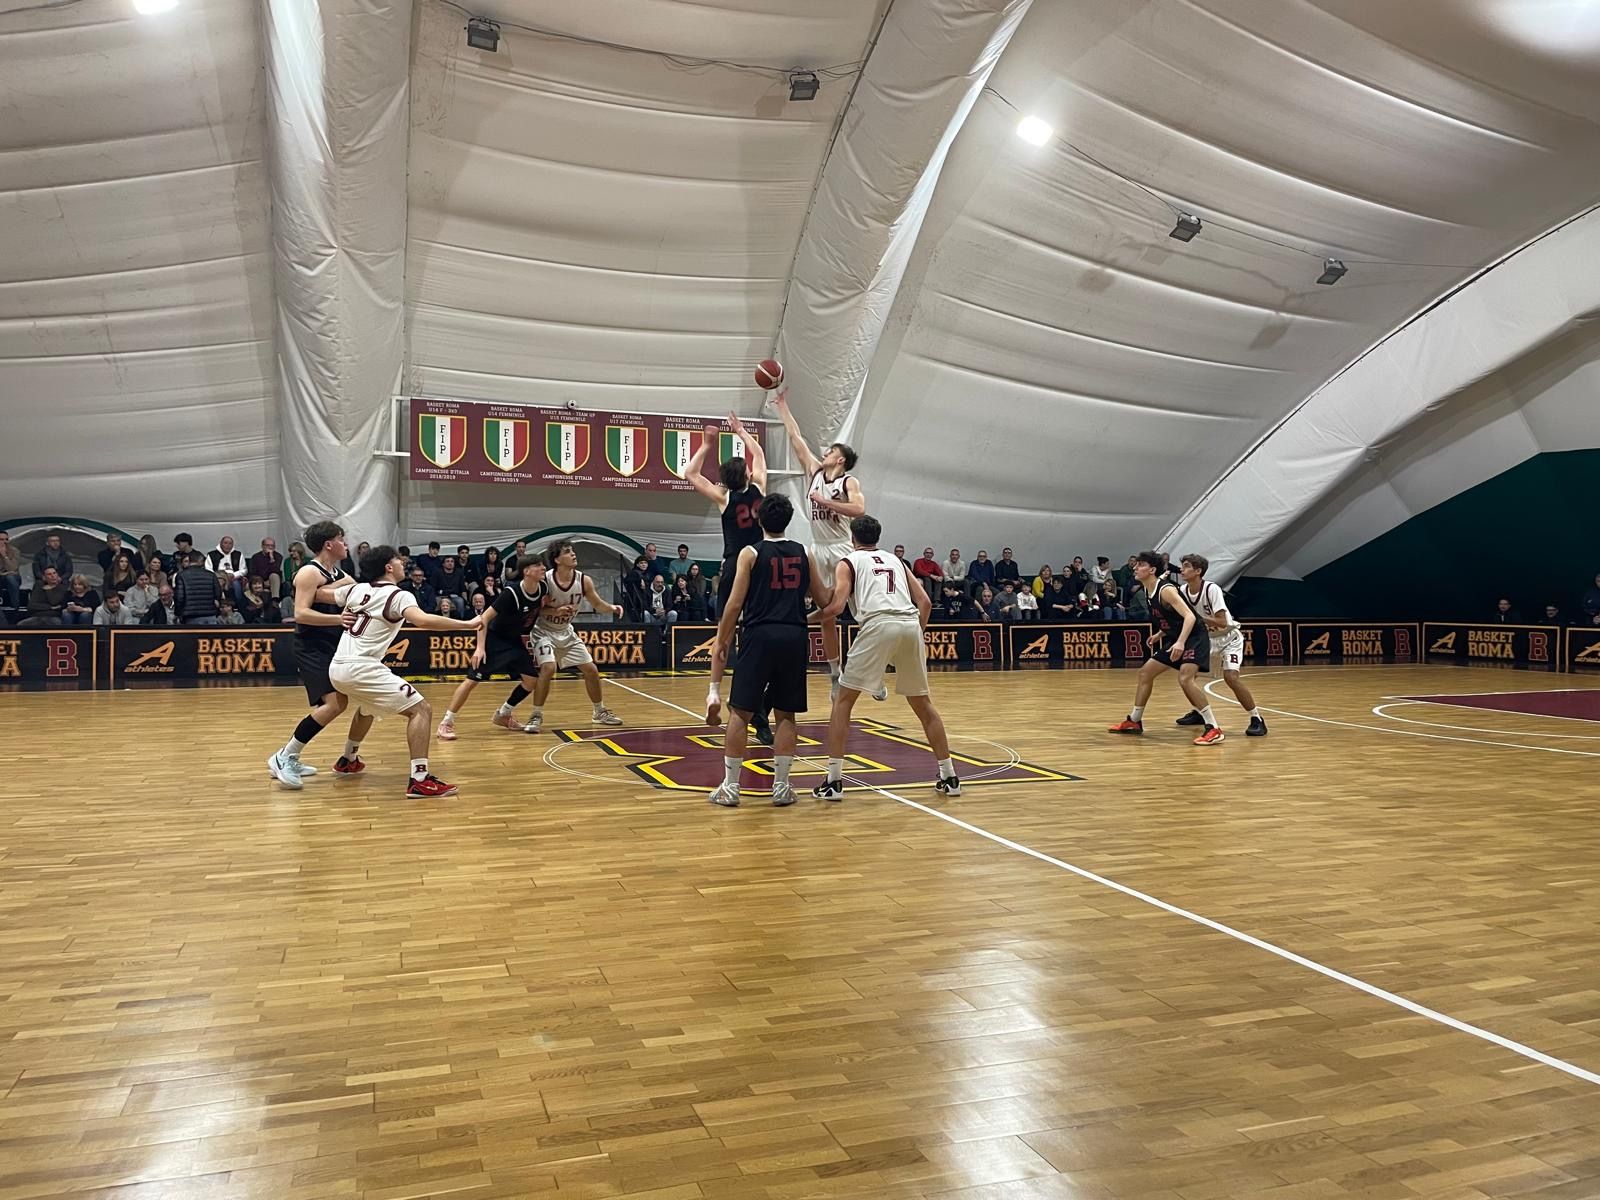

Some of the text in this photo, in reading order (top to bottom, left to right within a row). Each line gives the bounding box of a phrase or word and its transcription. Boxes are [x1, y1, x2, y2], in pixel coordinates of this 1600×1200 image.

[831, 489, 840, 499] 2
[770, 556, 801, 589] 15
[872, 568, 896, 594] 7
[570, 594, 581, 604] 17
[578, 631, 646, 644] BASKET
[924, 632, 957, 643] SKET
[1063, 631, 1110, 642] BASKET
[1266, 629, 1283, 655] B
[1342, 630, 1383, 640] BASKET
[1468, 630, 1515, 642] BASKET
[198, 638, 275, 652] BASKET
[430, 636, 476, 649] BASK
[973, 631, 993, 660] B
[1124, 630, 1143, 658] B
[1342, 641, 1383, 655] ROMA
[1528, 632, 1548, 661] B
[46, 639, 78, 676] B
[539, 646, 551, 655] 17
[1064, 643, 1111, 660] ROMA
[1468, 642, 1514, 659] ROMA
[198, 654, 275, 673] ROMA
[430, 651, 472, 668] ROM
[1230, 654, 1238, 663] B
[400, 684, 416, 698] 2
